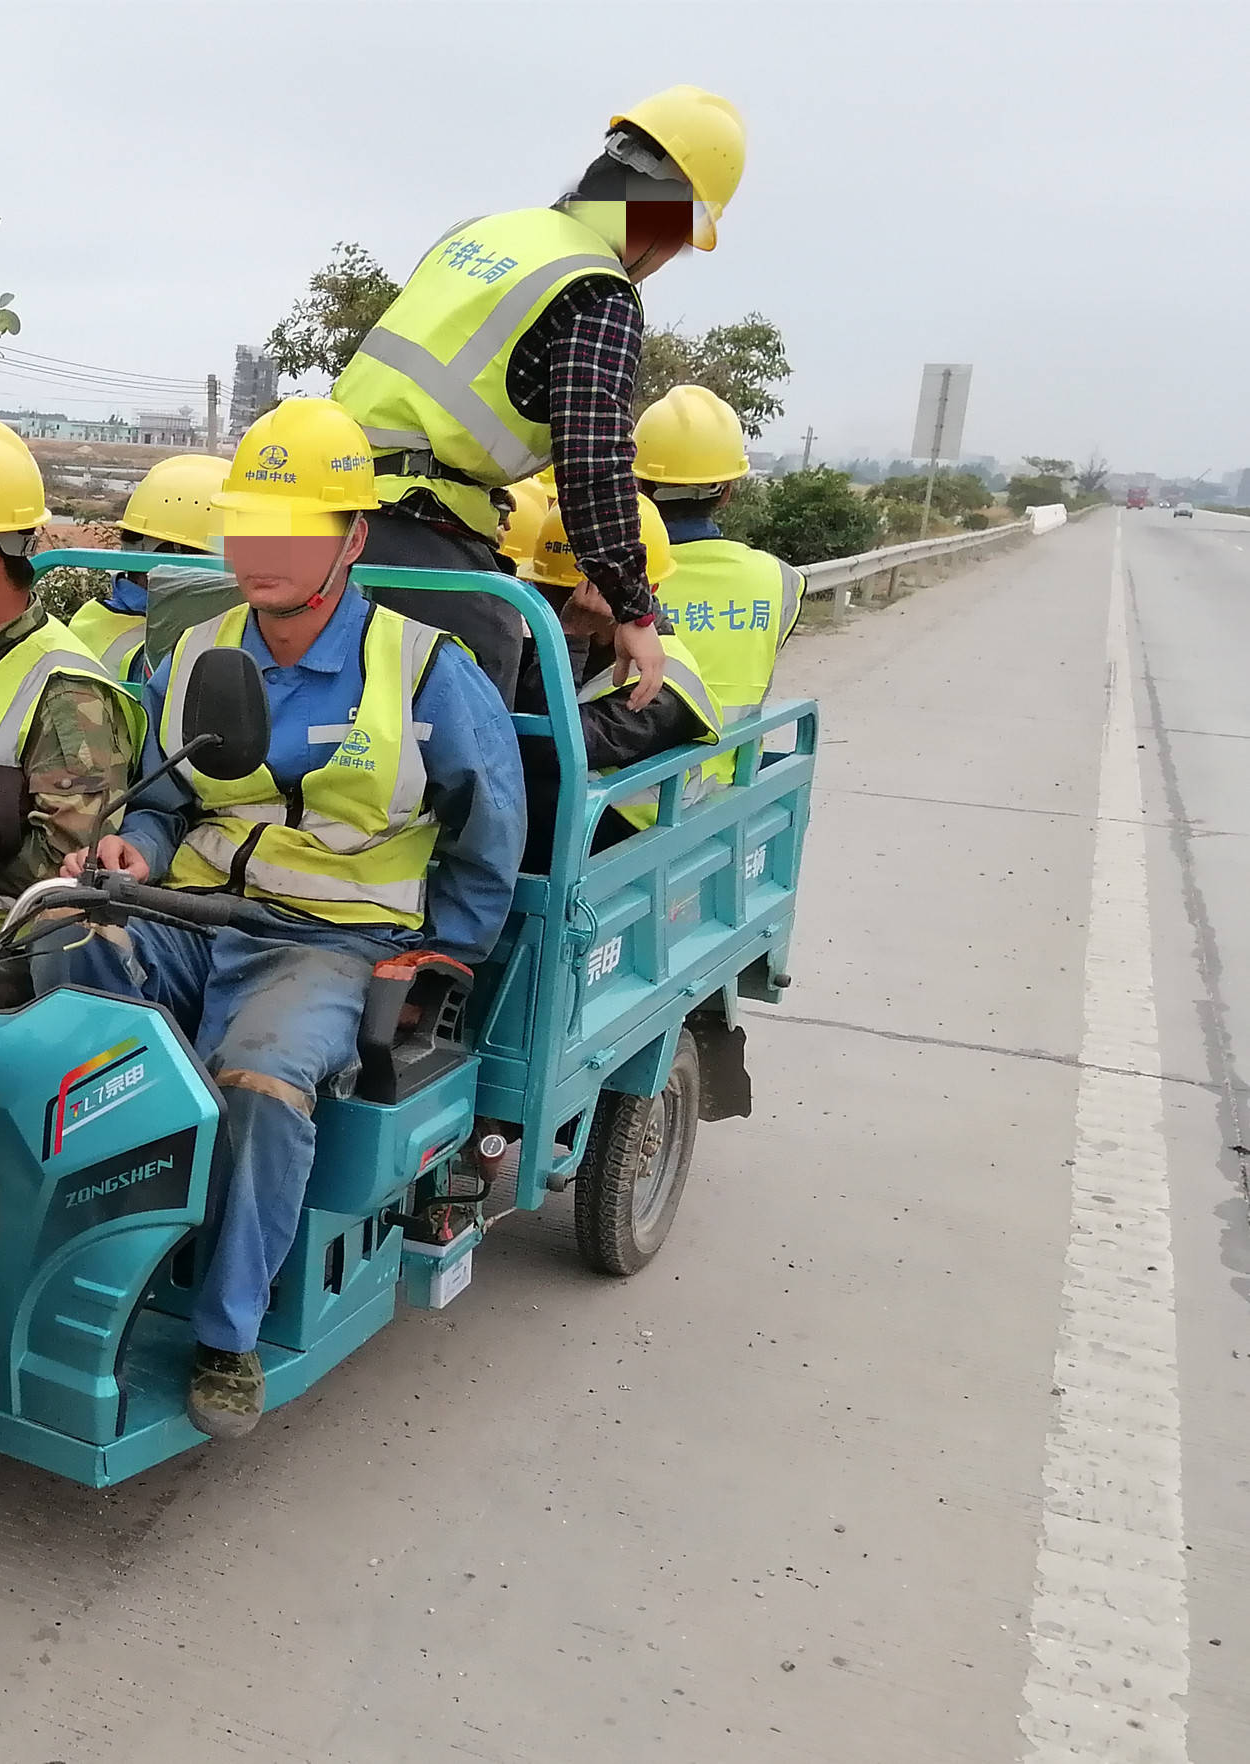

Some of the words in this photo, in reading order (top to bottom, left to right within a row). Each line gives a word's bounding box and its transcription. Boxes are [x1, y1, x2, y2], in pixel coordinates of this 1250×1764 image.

[437, 236, 518, 284] 中铁七局
[245, 469, 297, 484] 中国中铁
[587, 935, 623, 987] 宗申
[64, 1154, 174, 1209] ZONGSHEN
